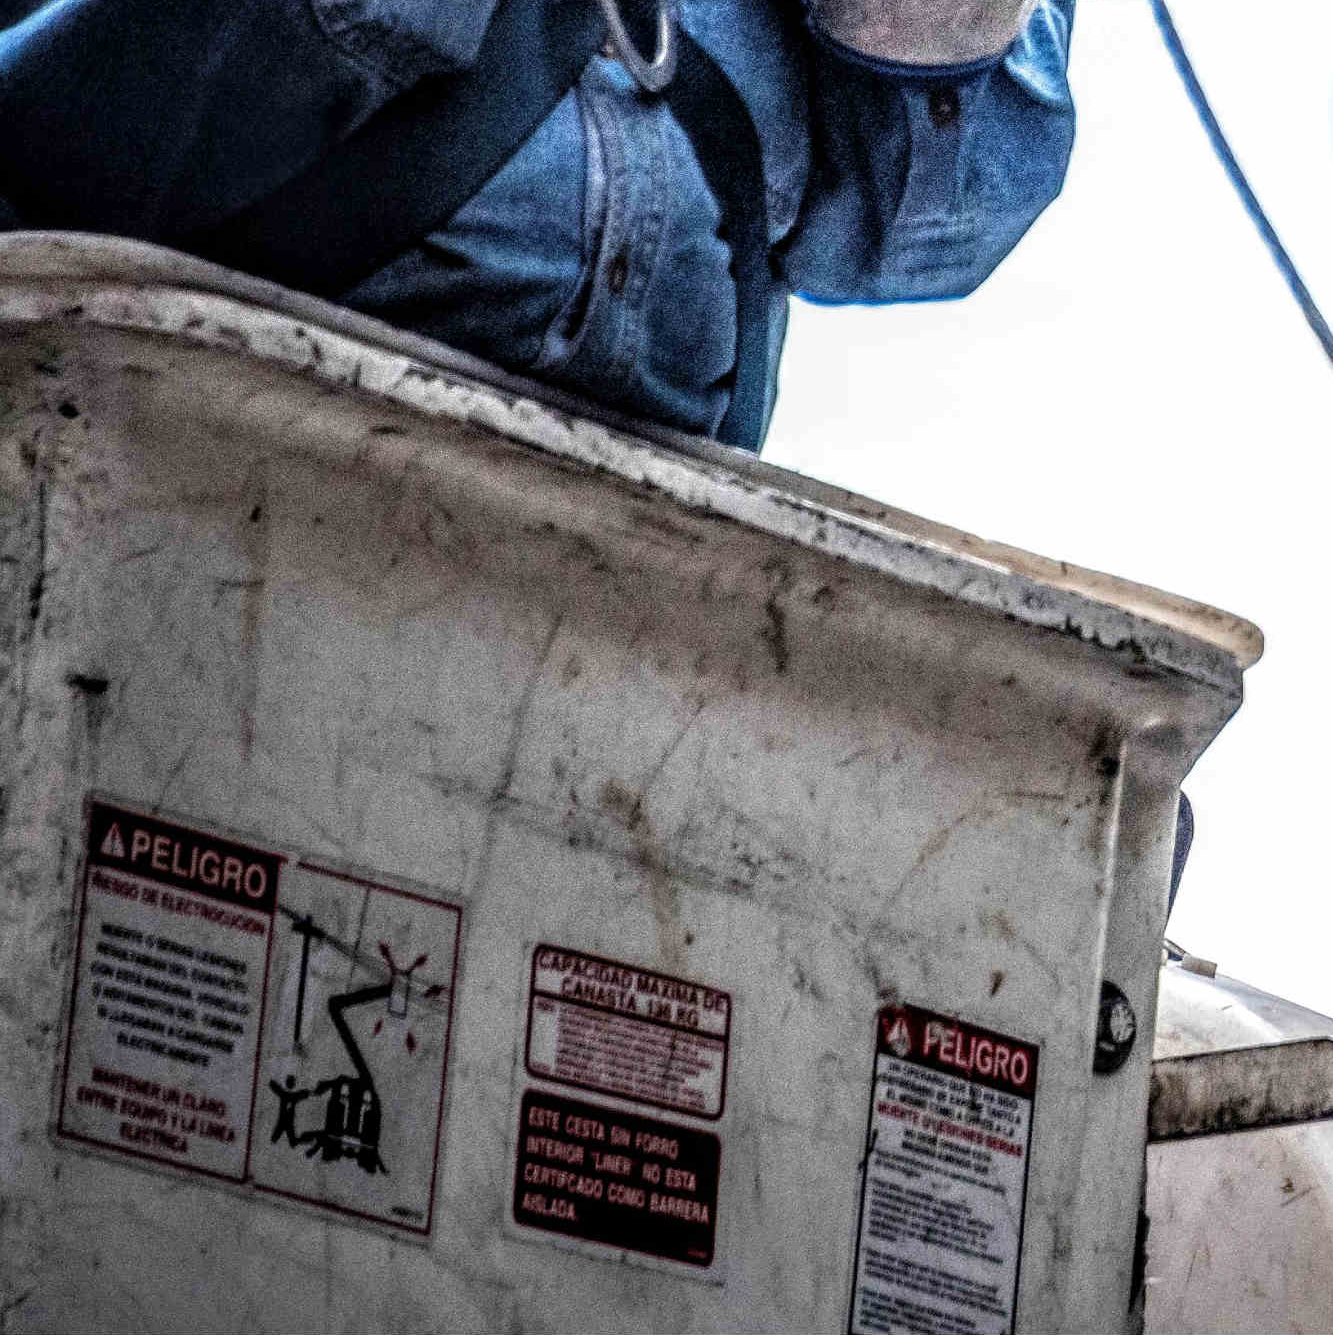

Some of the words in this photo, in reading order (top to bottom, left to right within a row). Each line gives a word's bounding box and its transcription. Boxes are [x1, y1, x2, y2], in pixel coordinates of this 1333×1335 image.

[131, 830, 267, 899] PELIGRO
[538, 951, 632, 989] CAPACIDAD
[637, 978, 699, 1004] MAXIMA
[703, 995, 724, 1012] DE
[923, 1021, 1029, 1086] PELIGRO
[528, 1106, 560, 1132] ESTE
[565, 1115, 605, 1141] CESTA
[611, 1126, 631, 1147] SIN
[635, 1133, 679, 1160] FORRO
[526, 1135, 584, 1165] INTERIOR
[642, 1164, 660, 1183] NO
[665, 1168, 697, 1192] ESTA
[608, 1183, 645, 1208] COMO
[650, 1194, 709, 1224] BARRERA
